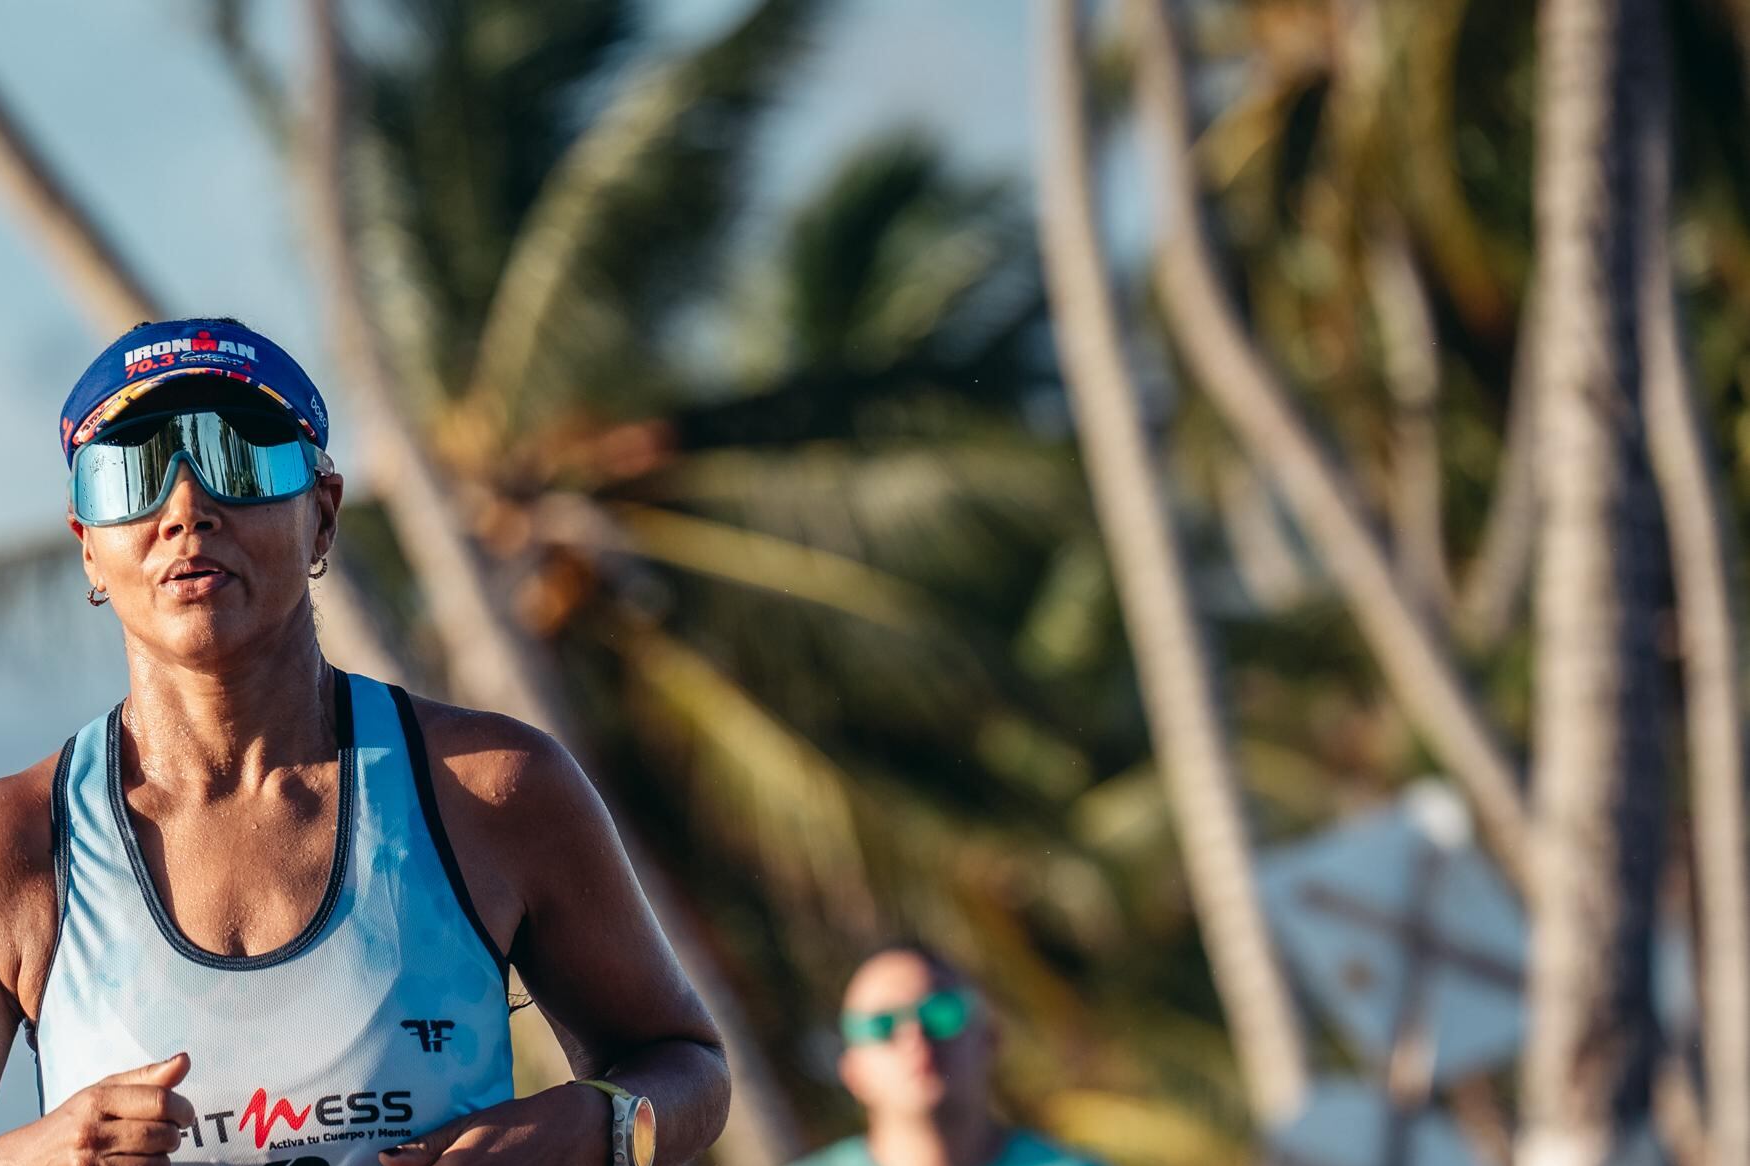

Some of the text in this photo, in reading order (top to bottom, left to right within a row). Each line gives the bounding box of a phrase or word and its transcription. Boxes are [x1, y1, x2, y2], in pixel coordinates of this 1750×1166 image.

[124, 332, 255, 366] IRONMAN
[124, 354, 175, 380] 70.3
[179, 1087, 413, 1149] ITNESS
[268, 1127, 413, 1151] Activa tu Cuerpo y Mente
